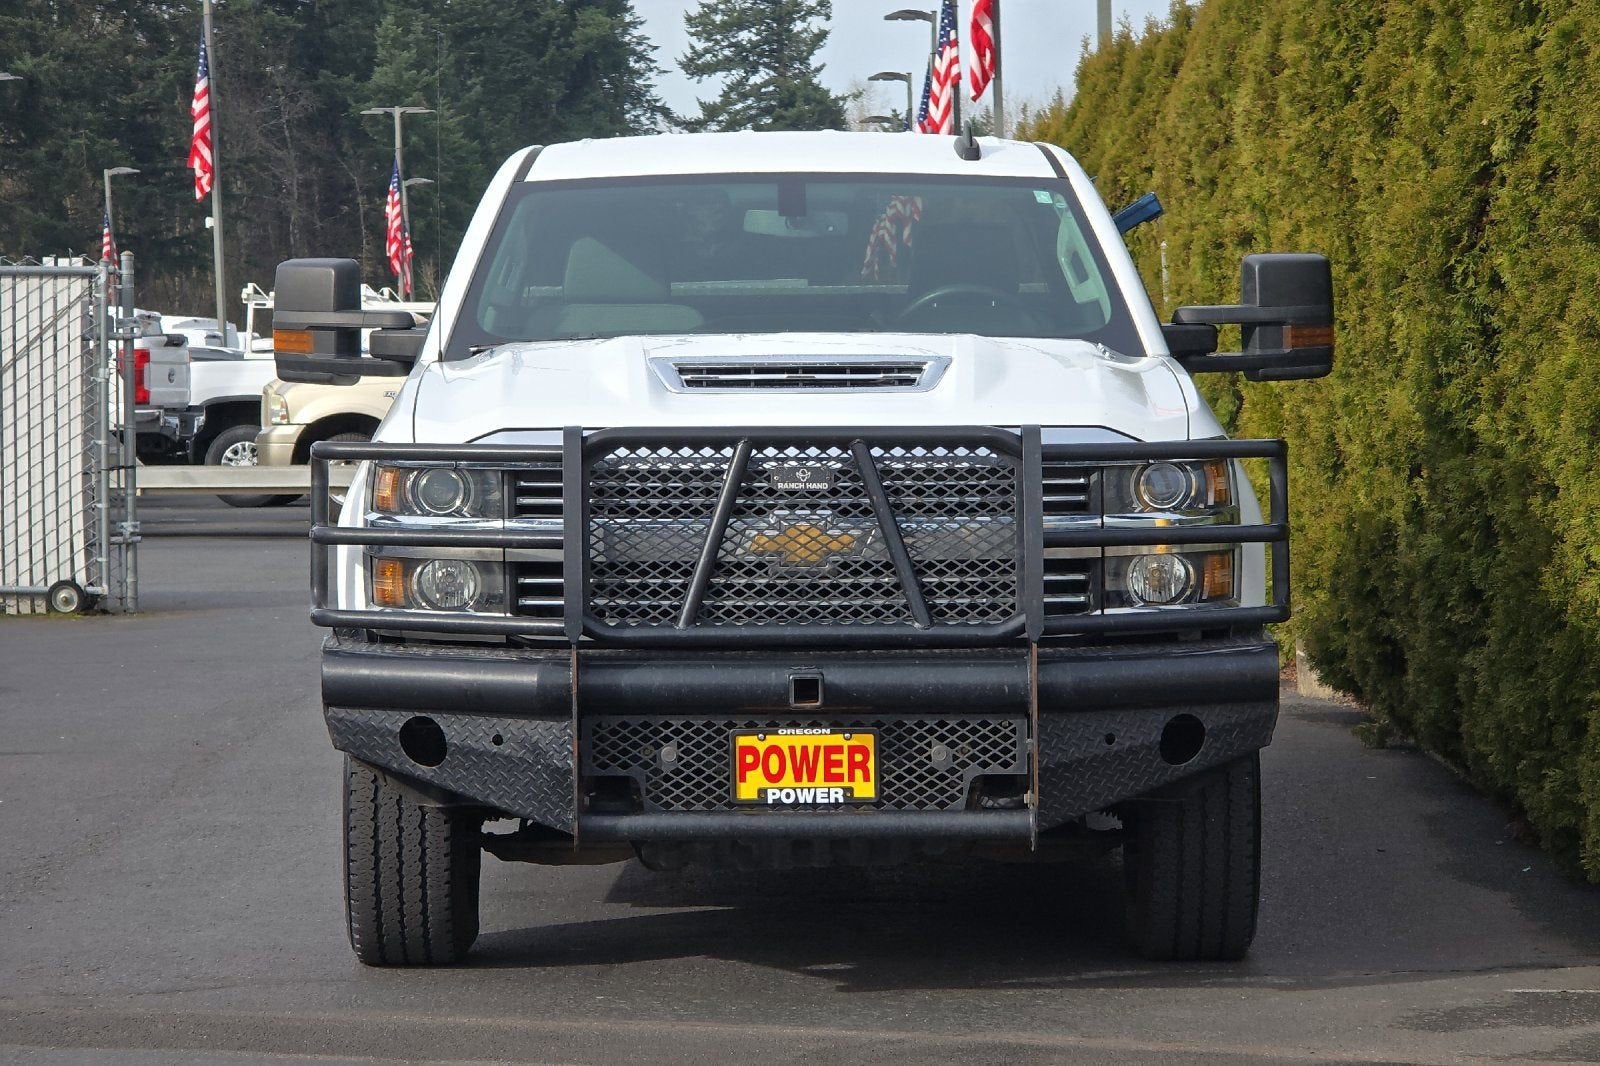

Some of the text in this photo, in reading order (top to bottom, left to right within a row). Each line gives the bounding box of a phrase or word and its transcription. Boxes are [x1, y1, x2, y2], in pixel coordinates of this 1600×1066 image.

[806, 482, 829, 490] HAND
[738, 744, 871, 784] POWER
[767, 788, 844, 804] POWER
